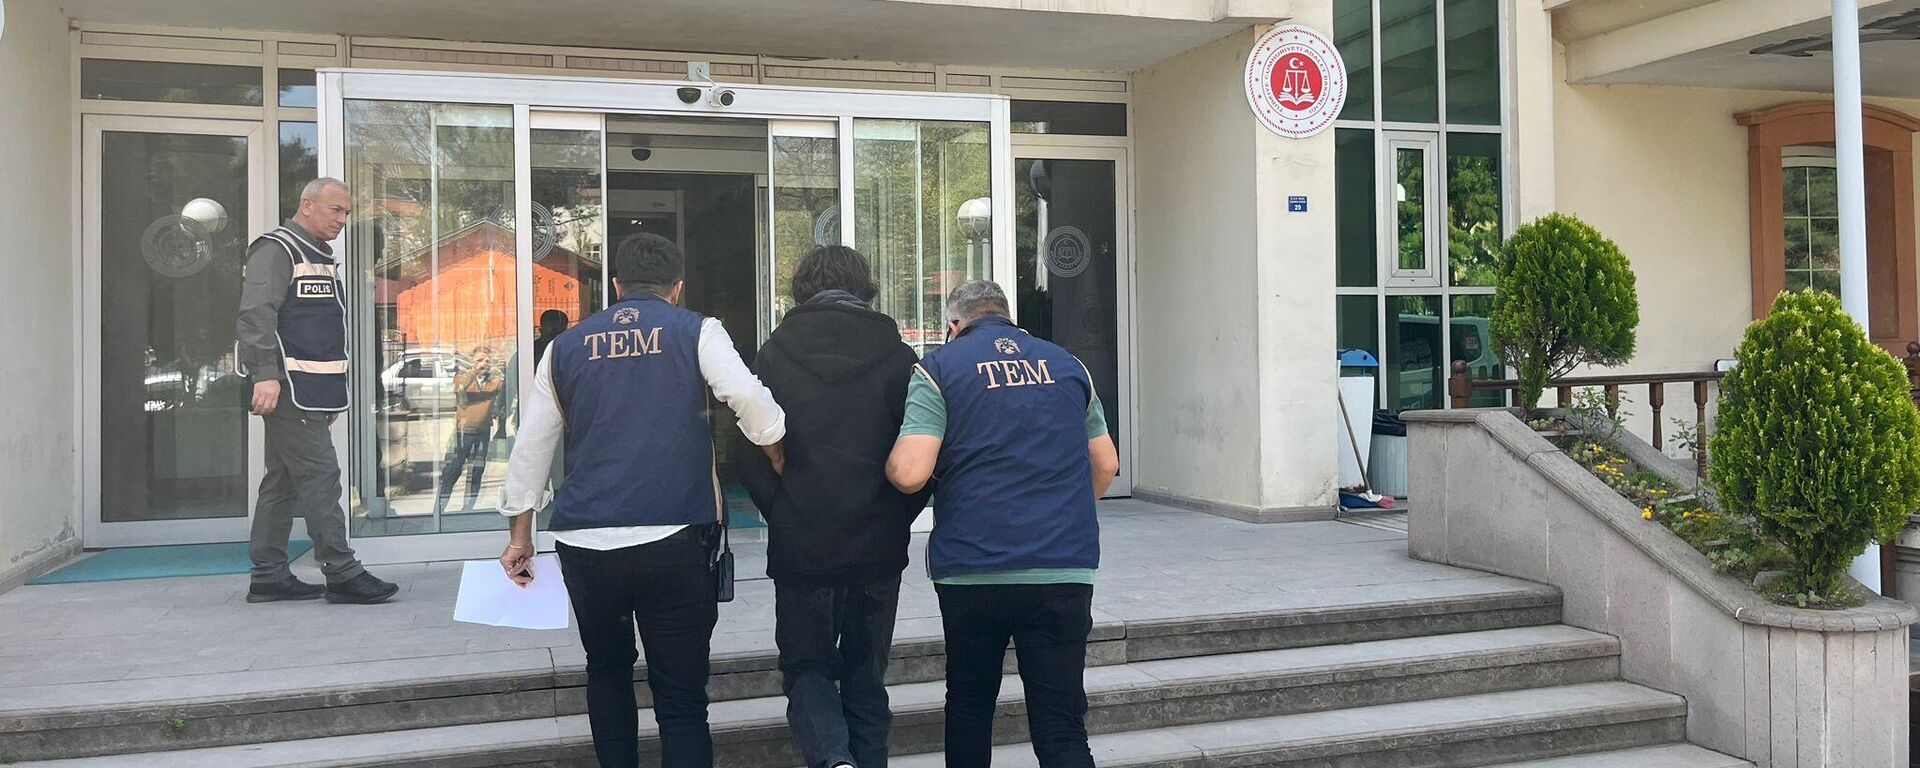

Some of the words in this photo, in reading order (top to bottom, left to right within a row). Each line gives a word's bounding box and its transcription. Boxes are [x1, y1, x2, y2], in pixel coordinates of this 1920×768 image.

[1304, 48, 1326, 73] ADALET
[584, 327, 663, 361] TEM
[976, 360, 1056, 389] TEM
